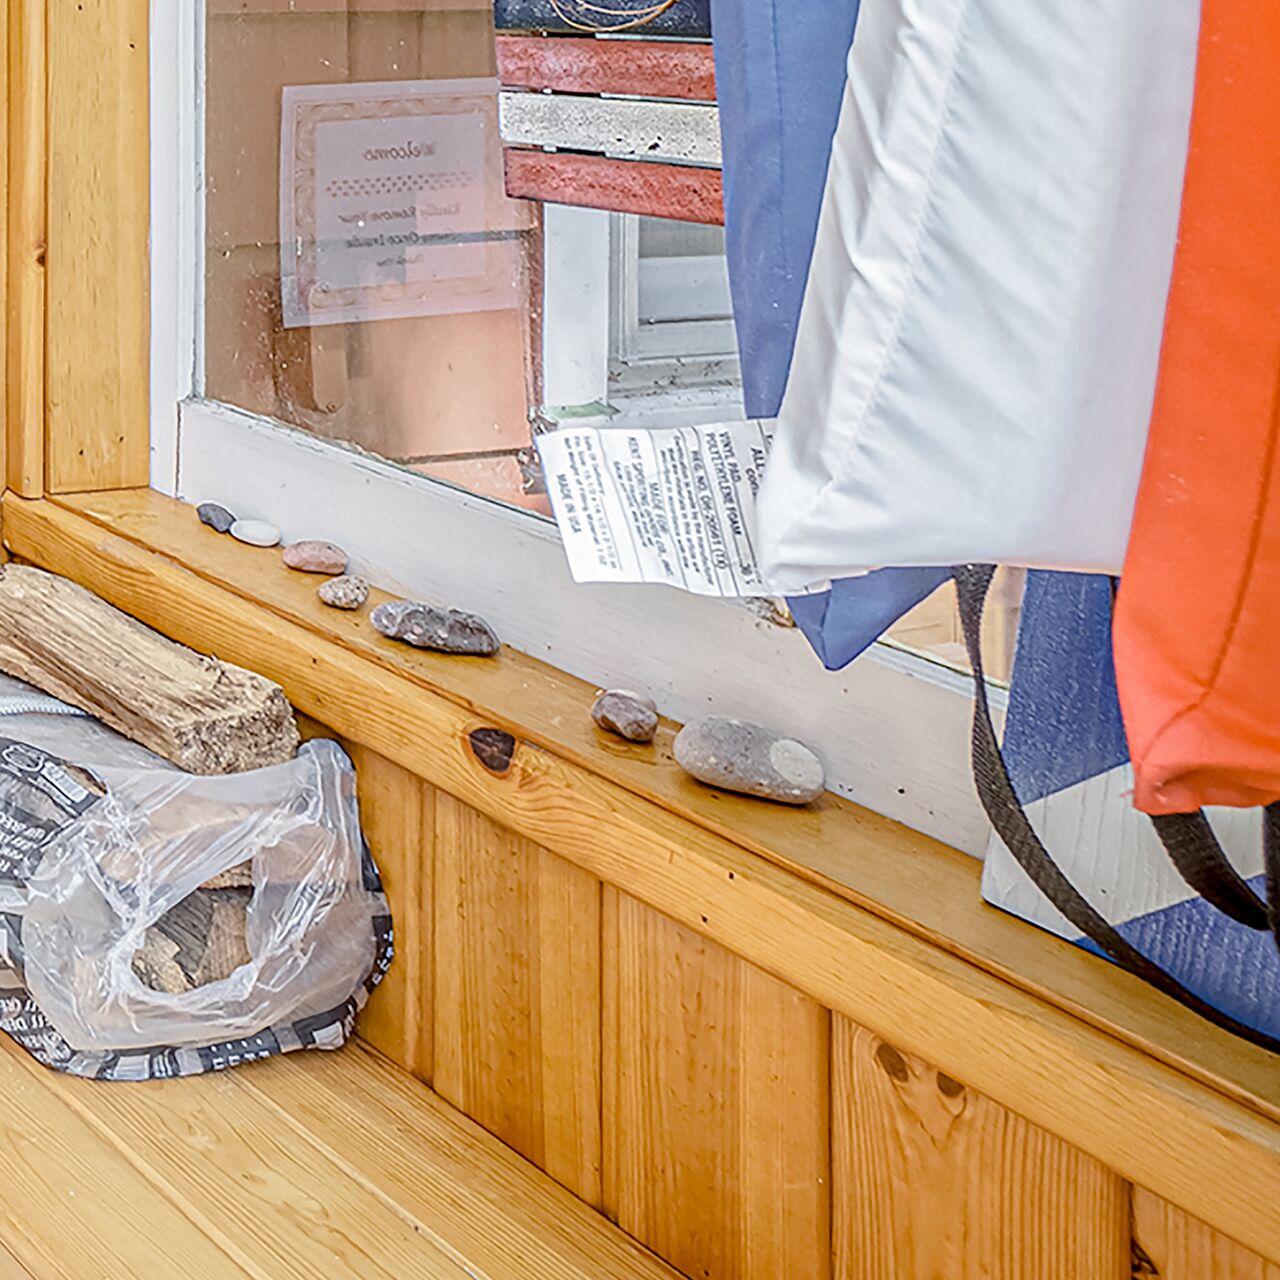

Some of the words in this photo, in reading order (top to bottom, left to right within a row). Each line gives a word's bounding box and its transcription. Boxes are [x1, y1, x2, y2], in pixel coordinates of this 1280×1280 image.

[718, 431, 735, 458] VINYL
[727, 461, 740, 483] PAD
[751, 446, 765, 469] ALL
[724, 505, 741, 536] FOAM
